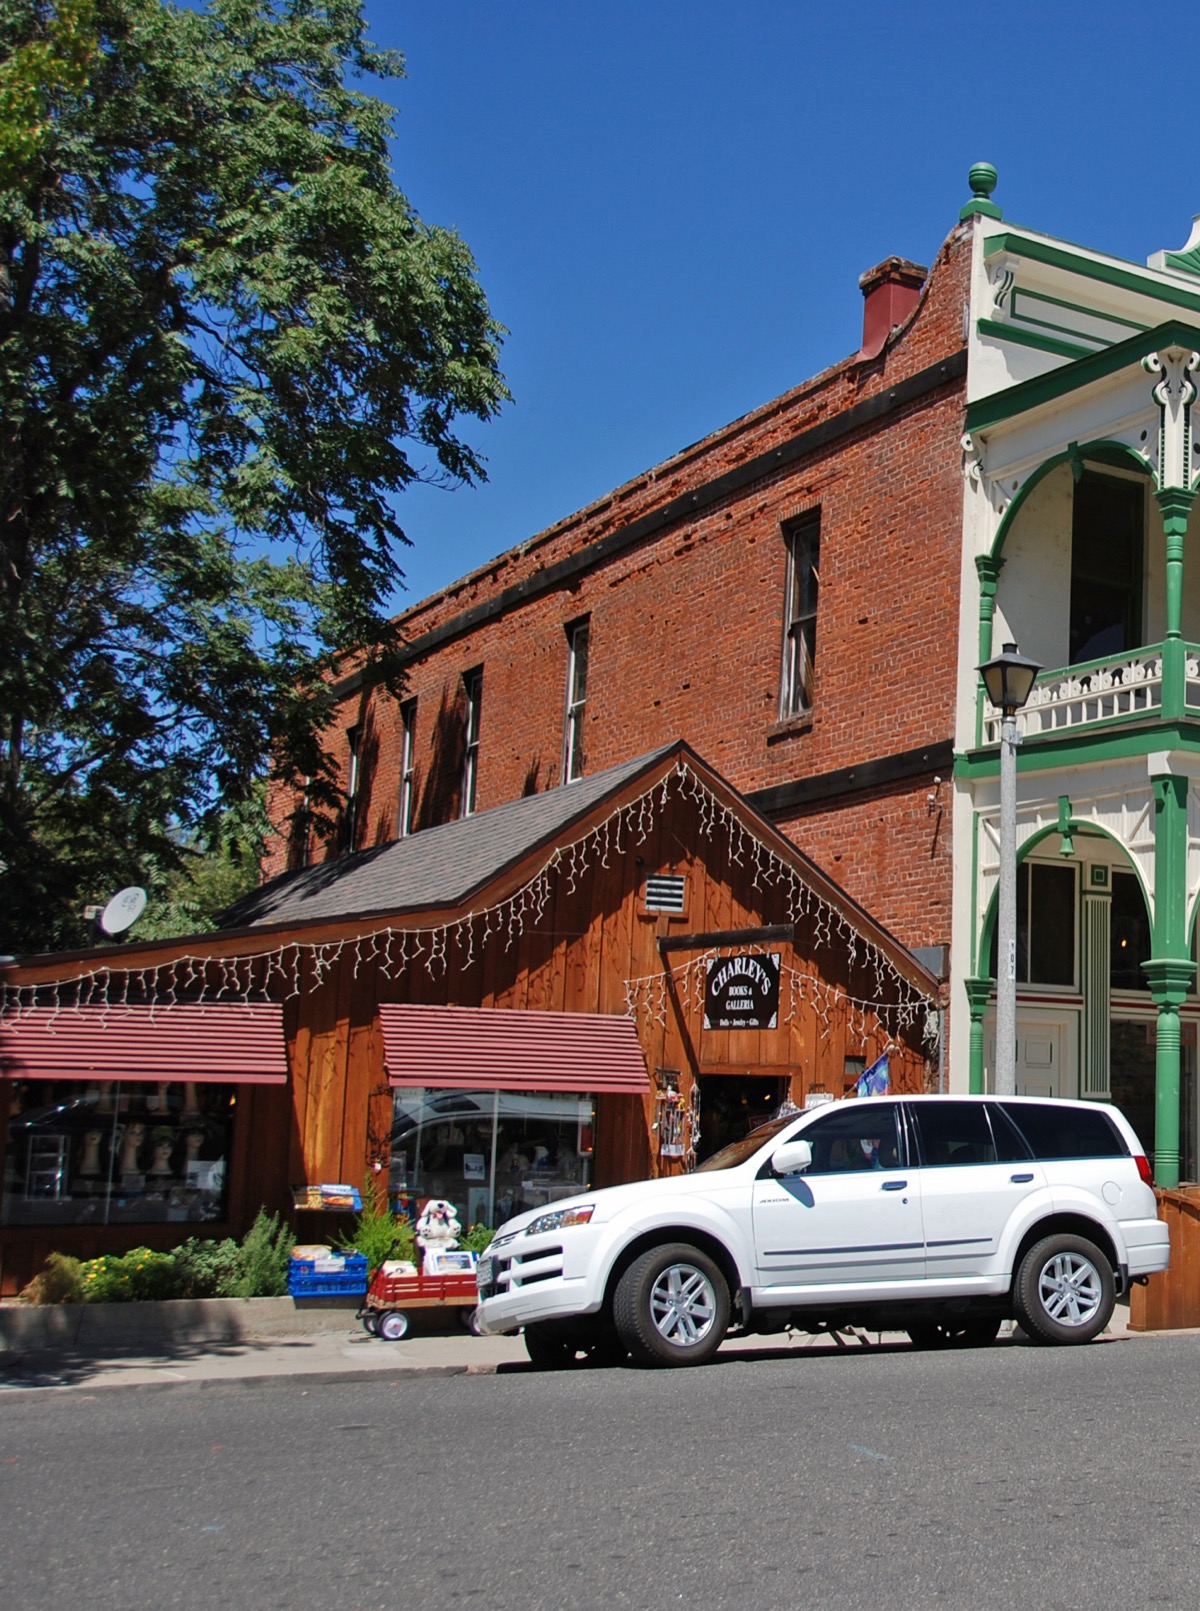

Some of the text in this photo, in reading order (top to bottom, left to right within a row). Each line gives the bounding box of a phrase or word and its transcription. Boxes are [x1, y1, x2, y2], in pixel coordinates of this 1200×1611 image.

[711, 957, 771, 996] CHARLEY'S
[729, 986, 748, 996] BOOKS
[725, 1000, 754, 1010] GALLERIA
